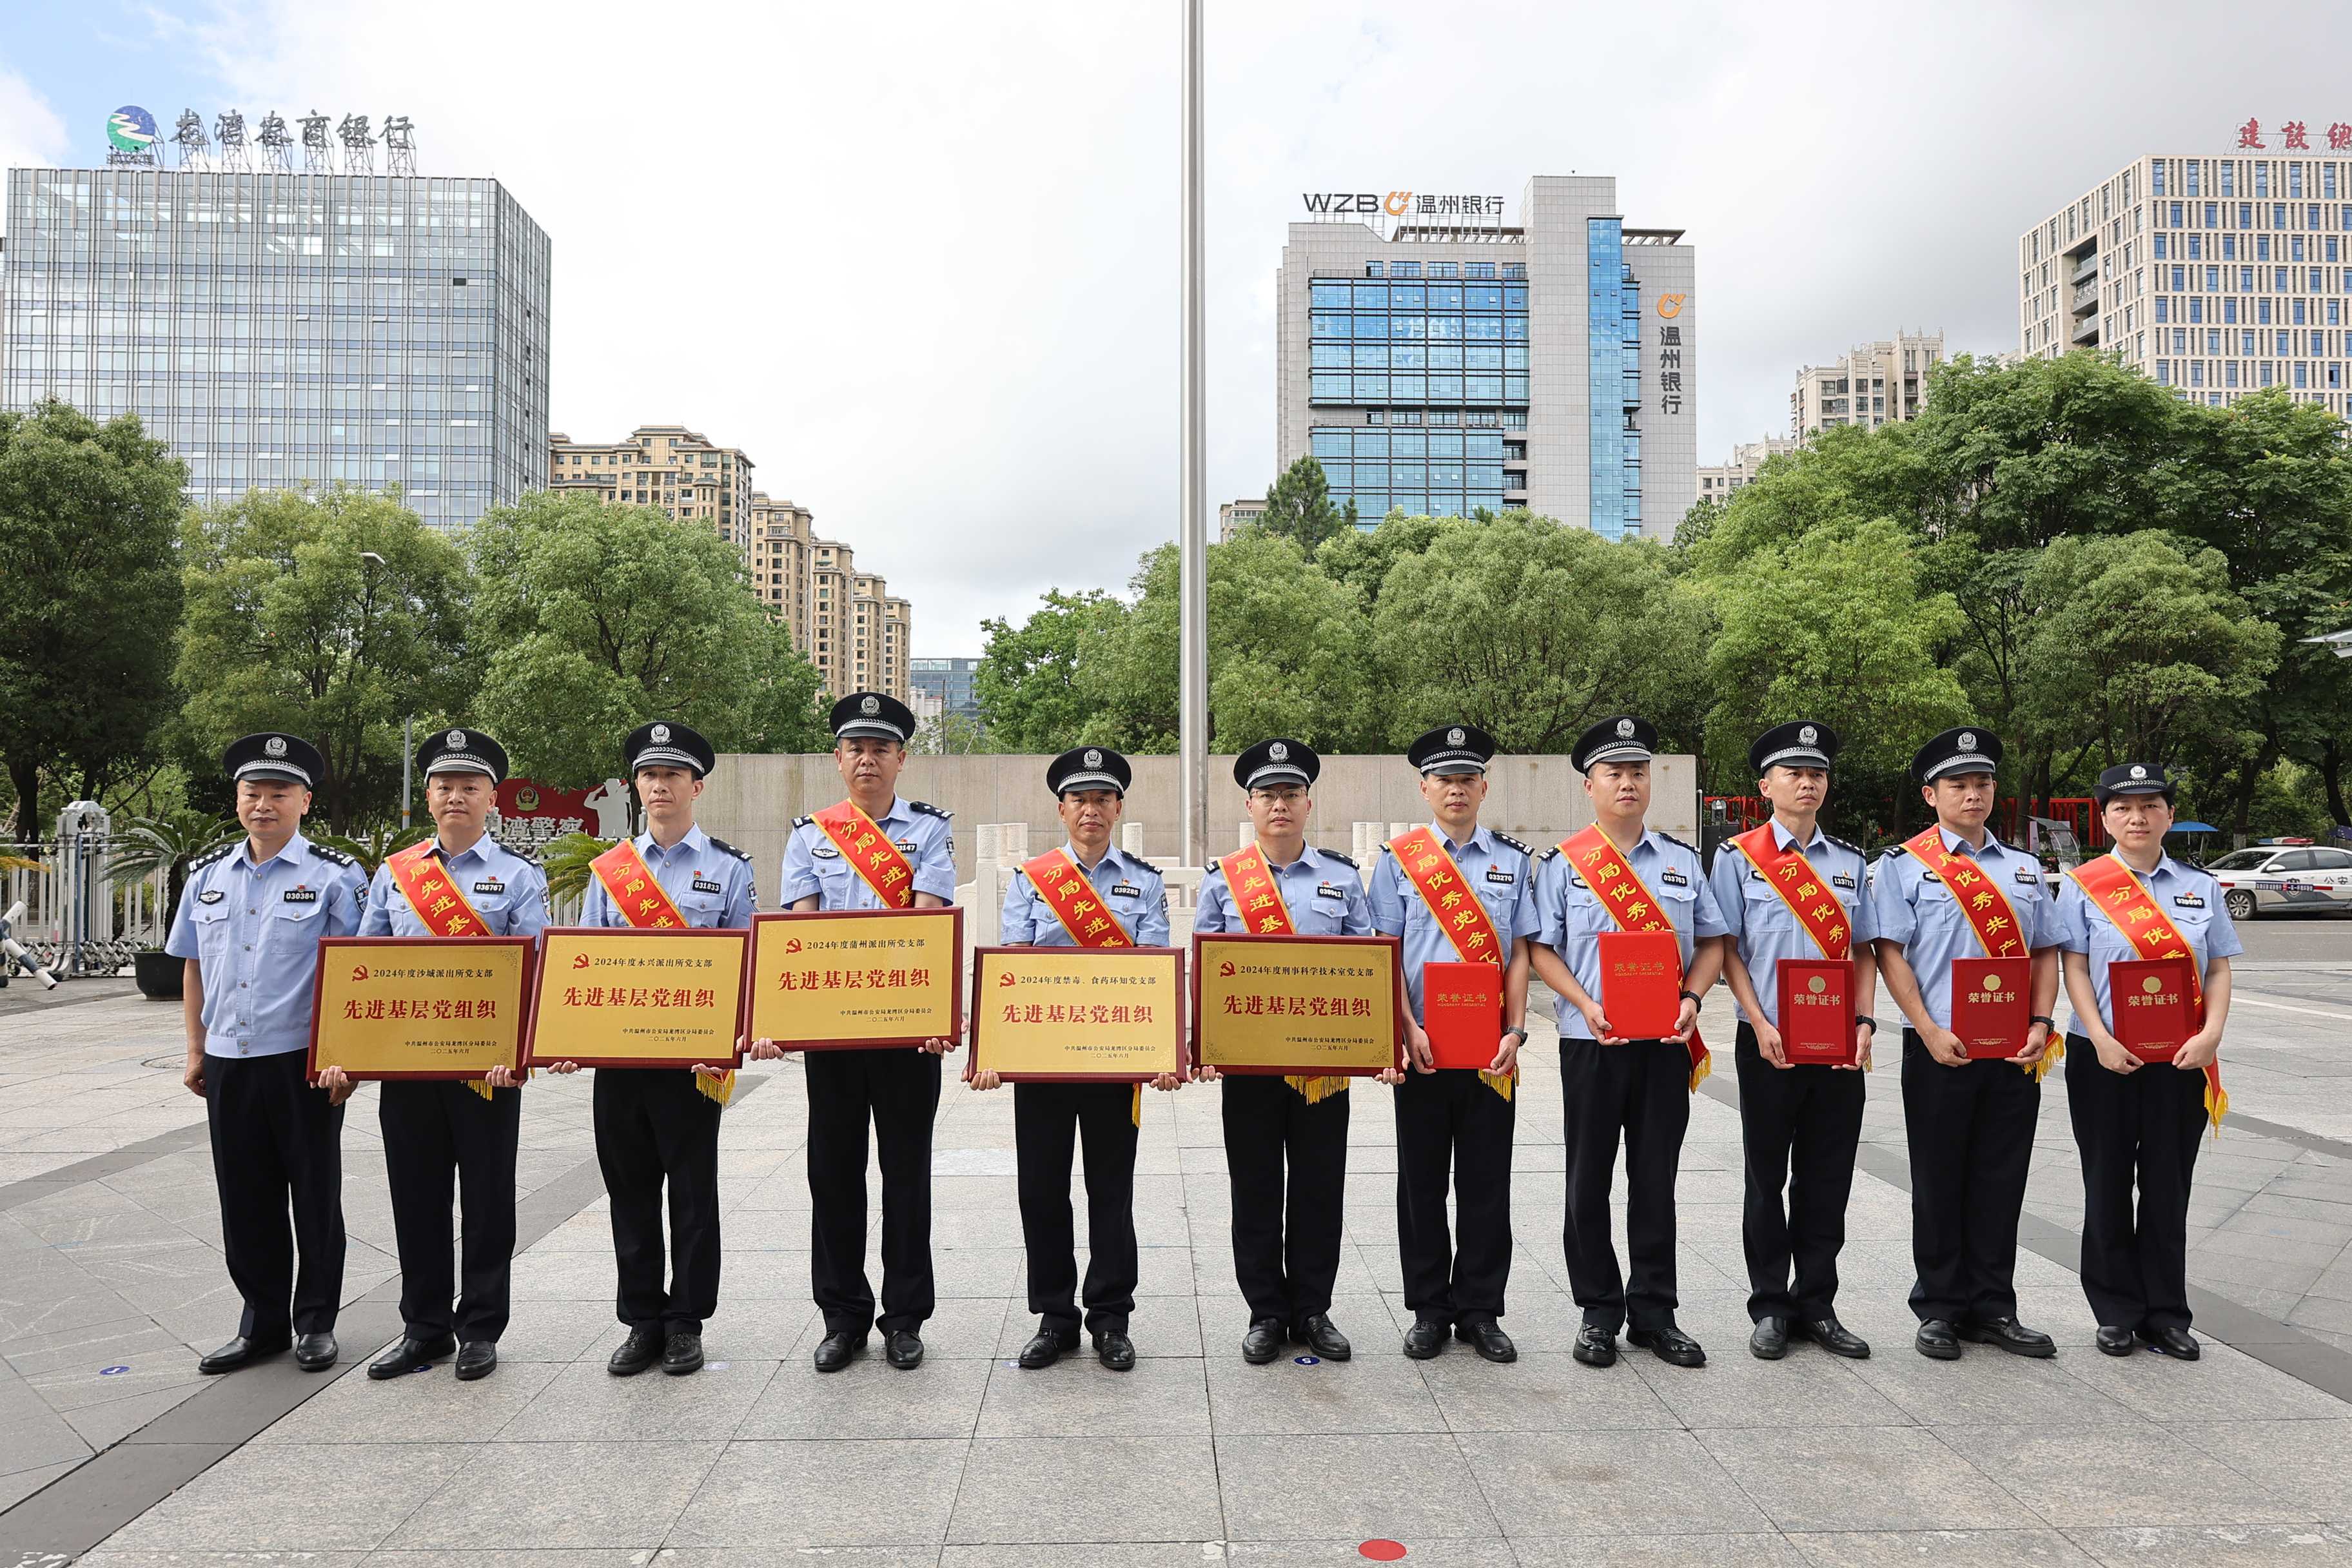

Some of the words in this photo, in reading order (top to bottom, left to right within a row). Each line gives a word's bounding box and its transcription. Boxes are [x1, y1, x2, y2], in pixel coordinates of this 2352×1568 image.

[1302, 193, 1379, 213] WZB
[1416, 195, 1504, 214] 温州银行
[1660, 326, 1681, 415] 温州银行
[694, 882, 720, 892] 031833
[2324, 876, 2349, 885] 公安
[400, 850, 481, 936] 分局先进基
[594, 957, 712, 967] 2024年度永兴派出所党支部
[373, 968, 493, 978] 2024年度沙城派出所党支部
[778, 968, 930, 991] 先进基层党组织
[562, 986, 714, 1008] 先进基层党组织
[1223, 995, 1371, 1017] 先进基层党组织
[1794, 994, 1840, 1006] 荣誉证书
[1968, 992, 2015, 1003] 荣誉证书
[2128, 994, 2178, 1006] 荣誉证书
[343, 999, 496, 1019] 先进基层党组织
[1002, 1004, 1153, 1023] 先进基层党组织
